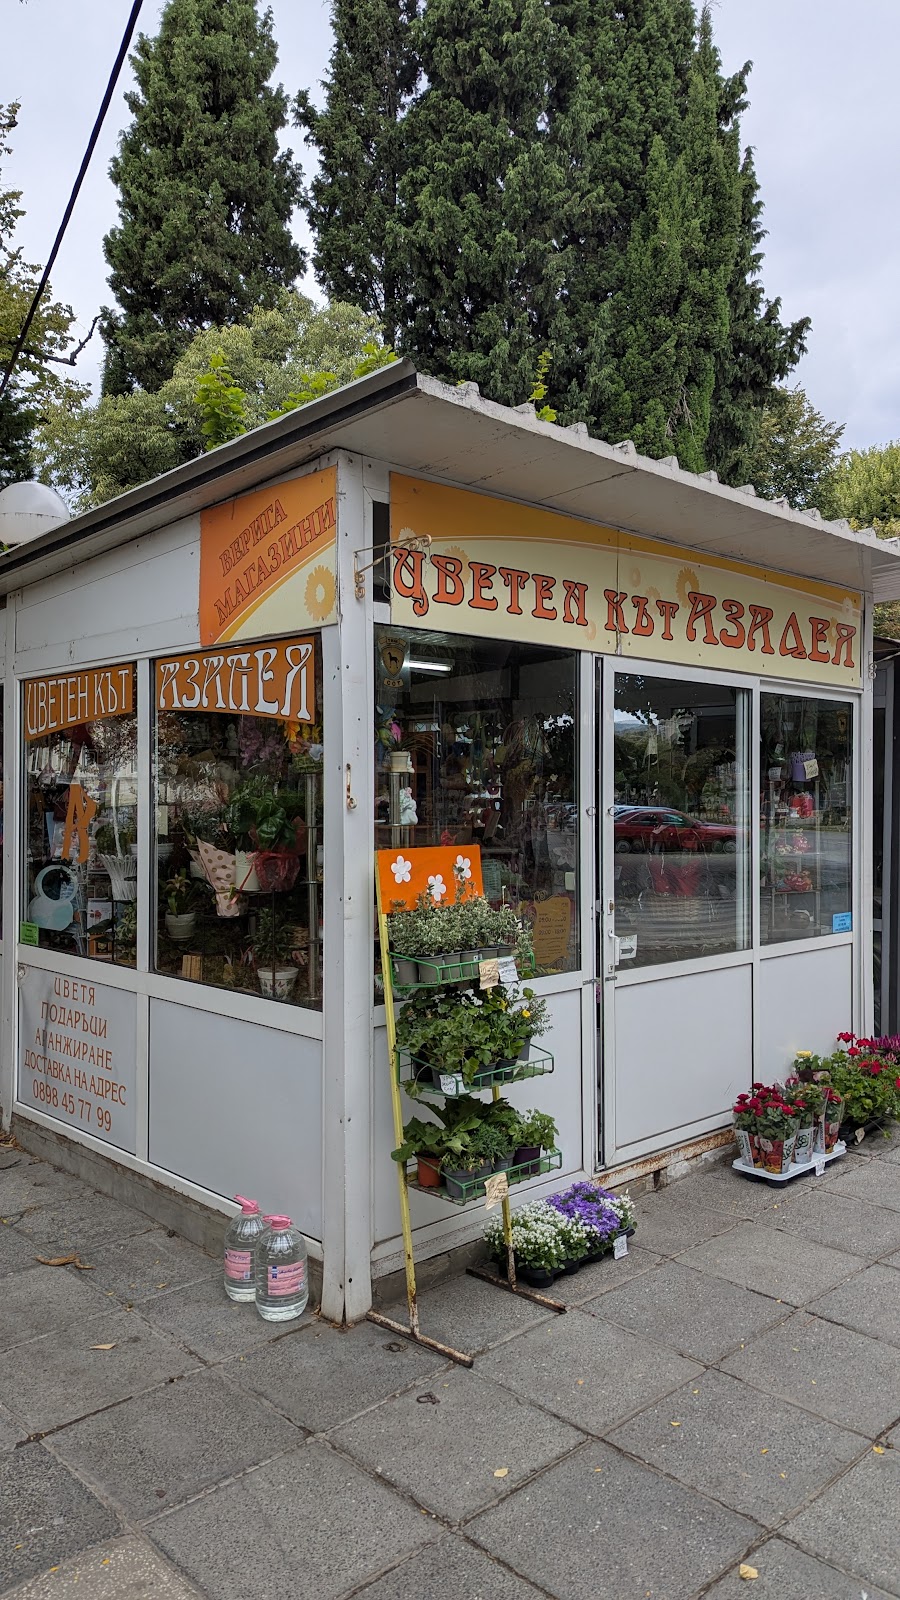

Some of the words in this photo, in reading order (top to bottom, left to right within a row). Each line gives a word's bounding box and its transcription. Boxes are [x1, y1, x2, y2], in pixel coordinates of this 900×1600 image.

[213, 497, 336, 626] МАГАЗИНИ
[218, 498, 288, 577] ВЕРИГА
[391, 546, 589, 626] ЦВЕТЕН
[603, 589, 679, 640] КЪТ
[26, 673, 89, 735] ЦВЕТЕН
[93, 669, 129, 715] КЪТ
[41, 1001, 107, 1039] ПОДАРЪЦИ
[54, 977, 95, 1006] ЦВЕТЯ
[24, 1048, 72, 1085] ДОСТАВКА
[74, 1068, 88, 1091] НА
[89, 1075, 127, 1106] АДРЕС
[35, 1027, 113, 1071] АРАНЖИРАНЕ
[33, 1079, 59, 1108] 0898
[61, 1092, 75, 1115] 45
[78, 1097, 92, 1122] 77
[96, 1106, 112, 1132] 99
